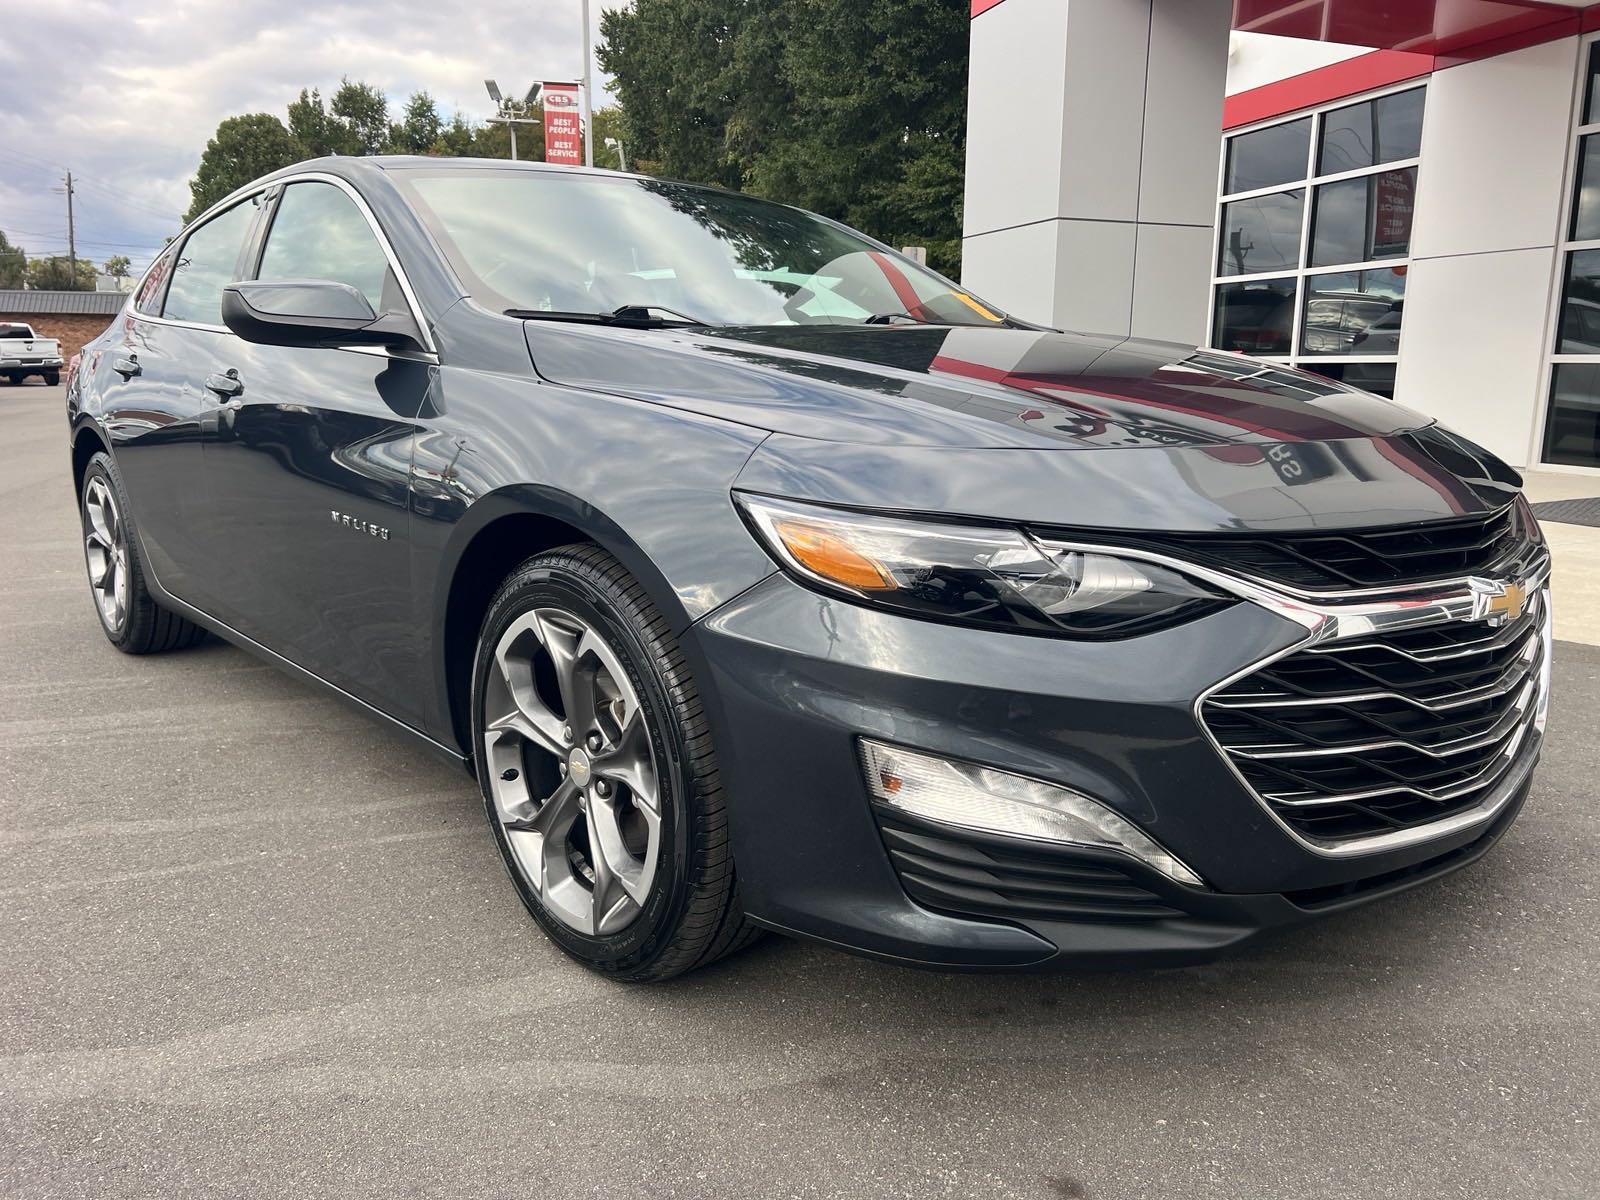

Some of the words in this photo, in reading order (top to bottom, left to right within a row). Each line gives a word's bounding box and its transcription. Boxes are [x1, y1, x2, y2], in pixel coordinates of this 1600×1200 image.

[549, 95, 569, 103] CBS
[553, 118, 572, 126] BEST
[549, 126, 576, 135] PEOPLE
[554, 141, 573, 149] BEST
[548, 149, 578, 158] SERVICE
[331, 510, 391, 541] MALIBU
